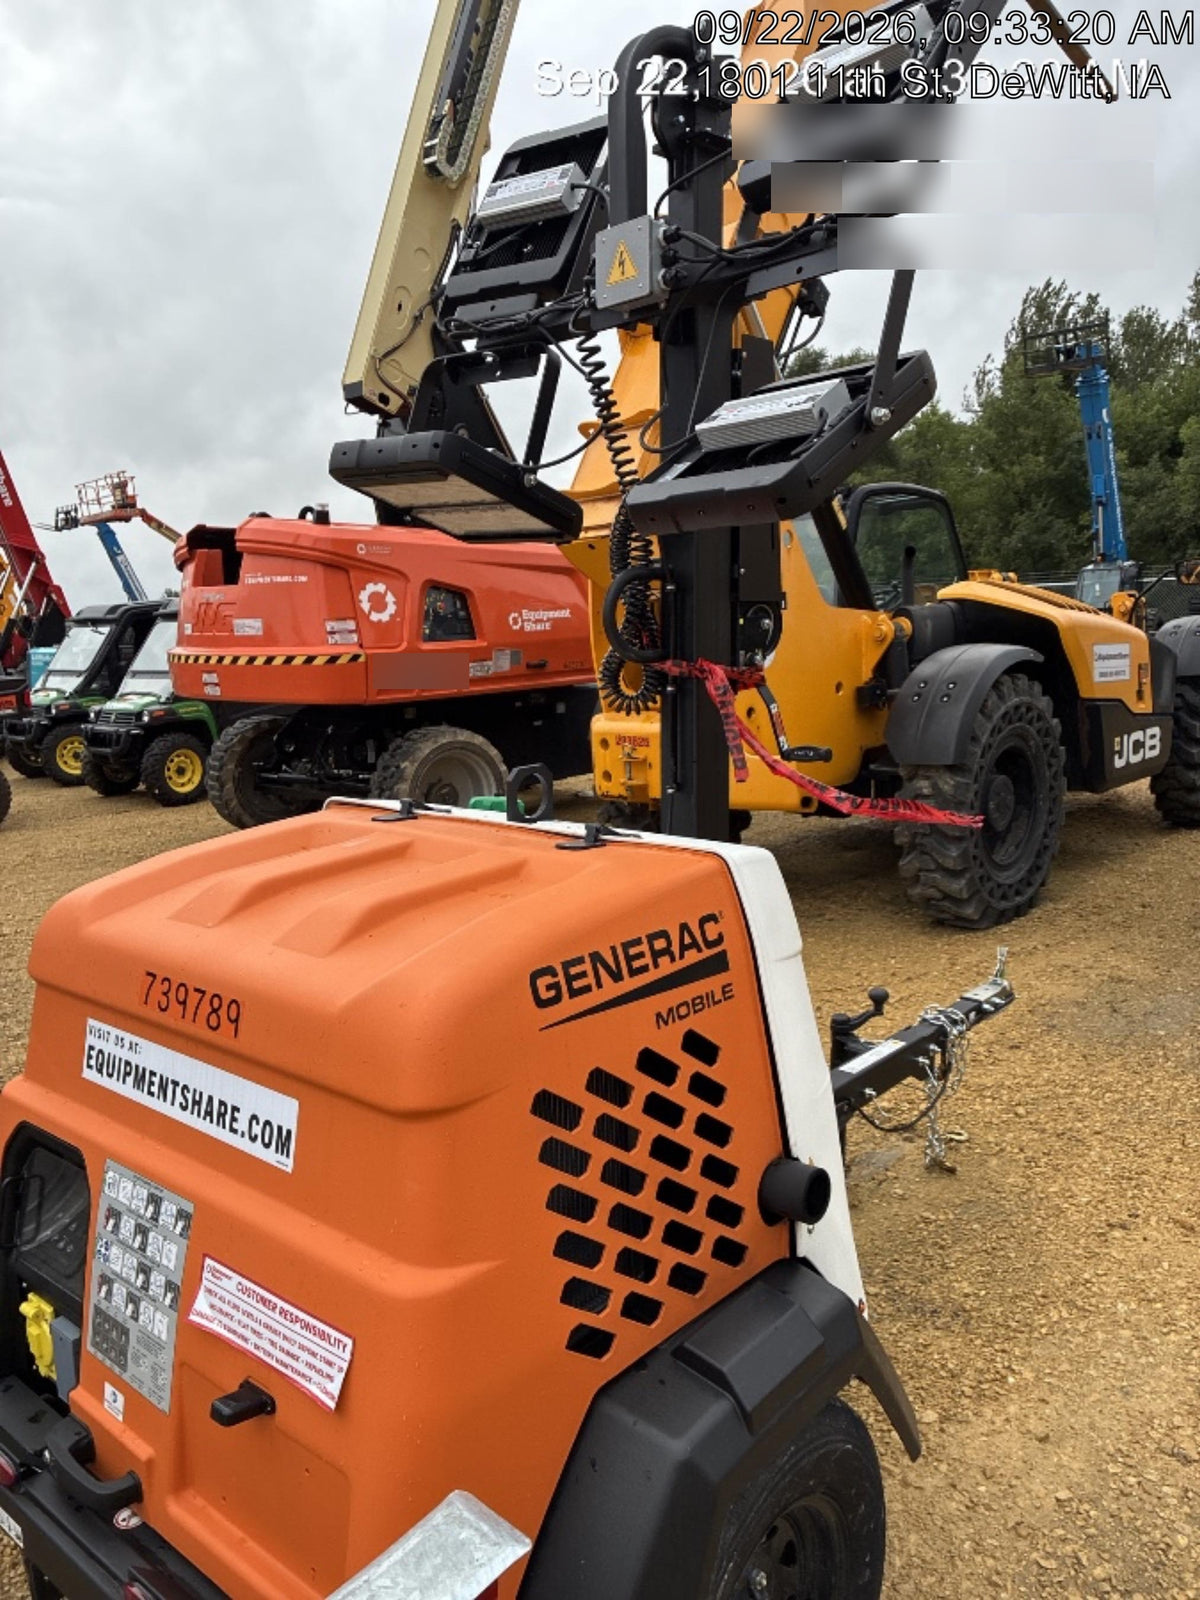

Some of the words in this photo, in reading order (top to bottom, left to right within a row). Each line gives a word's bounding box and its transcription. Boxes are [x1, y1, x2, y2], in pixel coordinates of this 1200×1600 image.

[1114, 726, 1161, 768] JCB
[529, 912, 725, 1009] GENERAC
[88, 1025, 111, 1044] VISIT
[143, 970, 242, 1039] 739789
[655, 982, 735, 1030] MOBILE
[86, 1045, 293, 1159] EQUIPMENTSHARE.COM
[236, 1281, 278, 1313] CUSTOMER
[279, 1306, 348, 1354] RESPONSIBILITY
